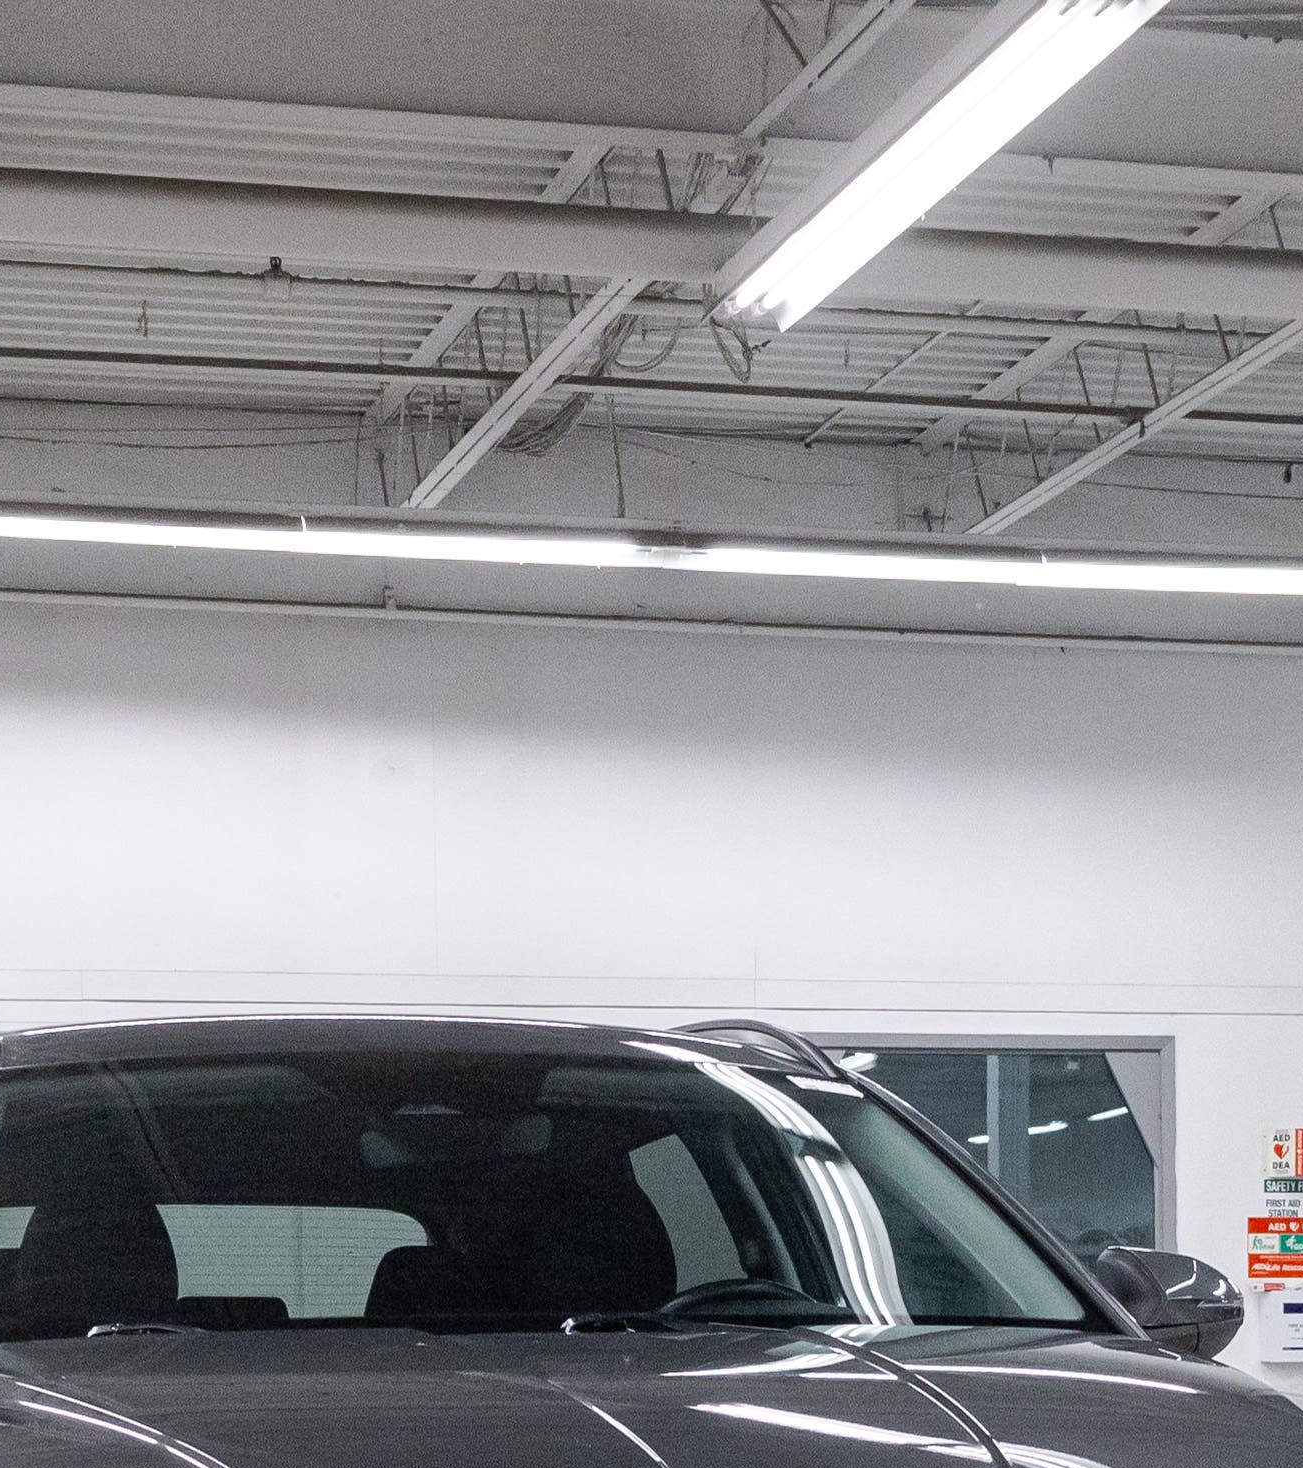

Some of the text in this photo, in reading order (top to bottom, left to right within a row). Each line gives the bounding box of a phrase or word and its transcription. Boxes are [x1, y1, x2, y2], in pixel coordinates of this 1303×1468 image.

[1265, 1181, 1296, 1192] SAFETY
[1265, 1199, 1301, 1207] FIRST AID
[1268, 1209, 1298, 1217] STATION
[1268, 1223, 1287, 1231] AED
